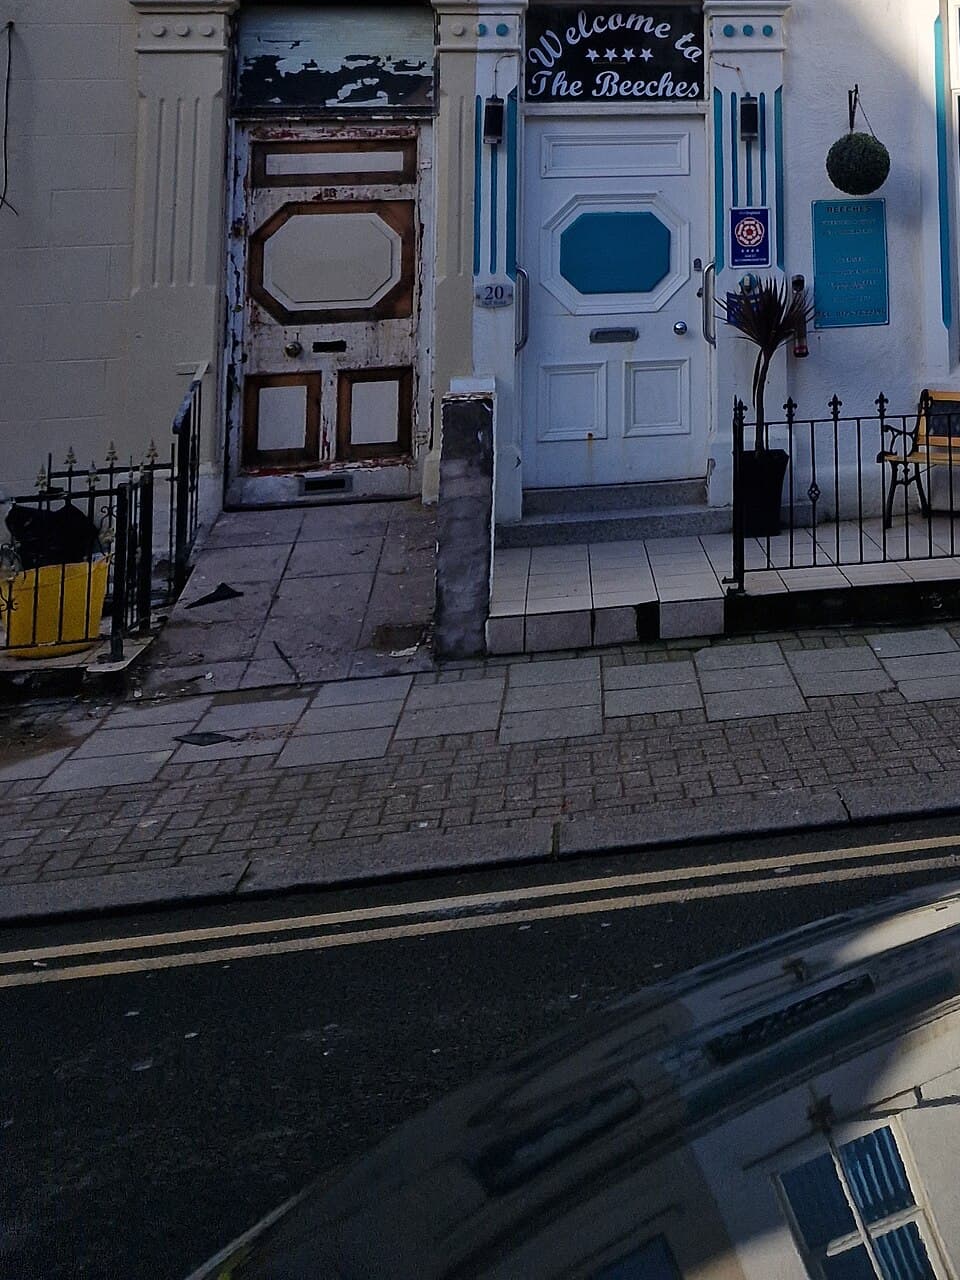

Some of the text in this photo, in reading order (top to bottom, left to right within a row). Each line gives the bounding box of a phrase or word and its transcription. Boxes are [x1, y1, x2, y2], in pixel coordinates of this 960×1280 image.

[528, 10, 703, 68] Welcome to
[528, 70, 701, 98] The Beeches
[484, 286, 504, 300] 20
